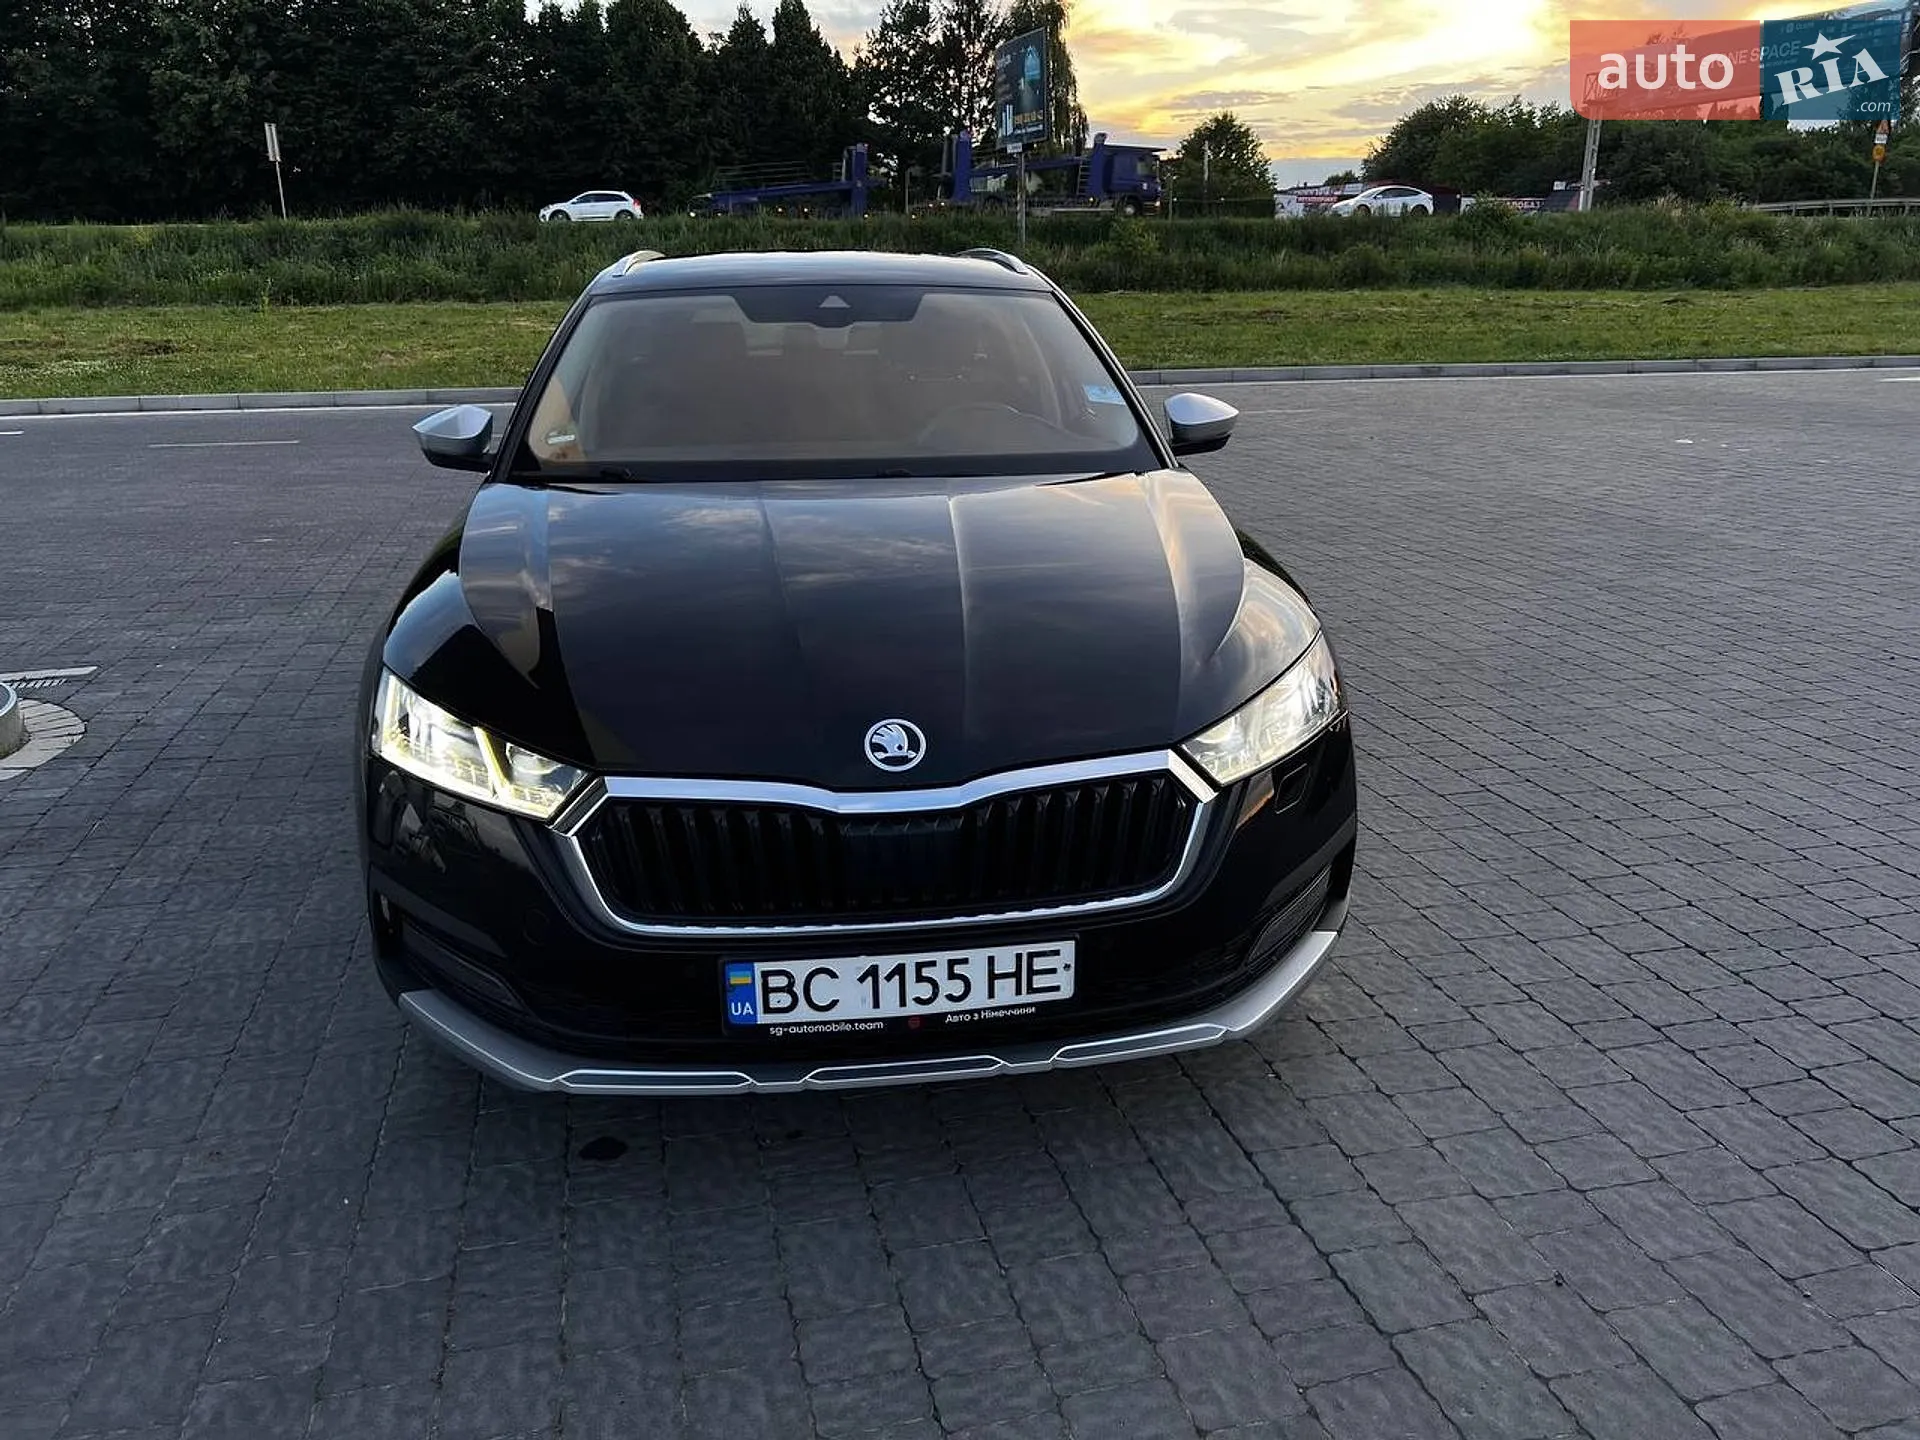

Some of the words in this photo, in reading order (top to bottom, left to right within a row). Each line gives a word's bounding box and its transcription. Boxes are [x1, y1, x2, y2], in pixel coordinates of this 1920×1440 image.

[1750, 41, 1802, 62] SPACE
[761, 967, 840, 1014] BC
[857, 957, 972, 1009] 1155
[988, 949, 1061, 999] HE
[731, 1002, 754, 1016] UA
[945, 1013, 971, 1024] Авто
[981, 1006, 1037, 1019] Німеччини
[769, 1021, 884, 1036] sg-automobile.team
